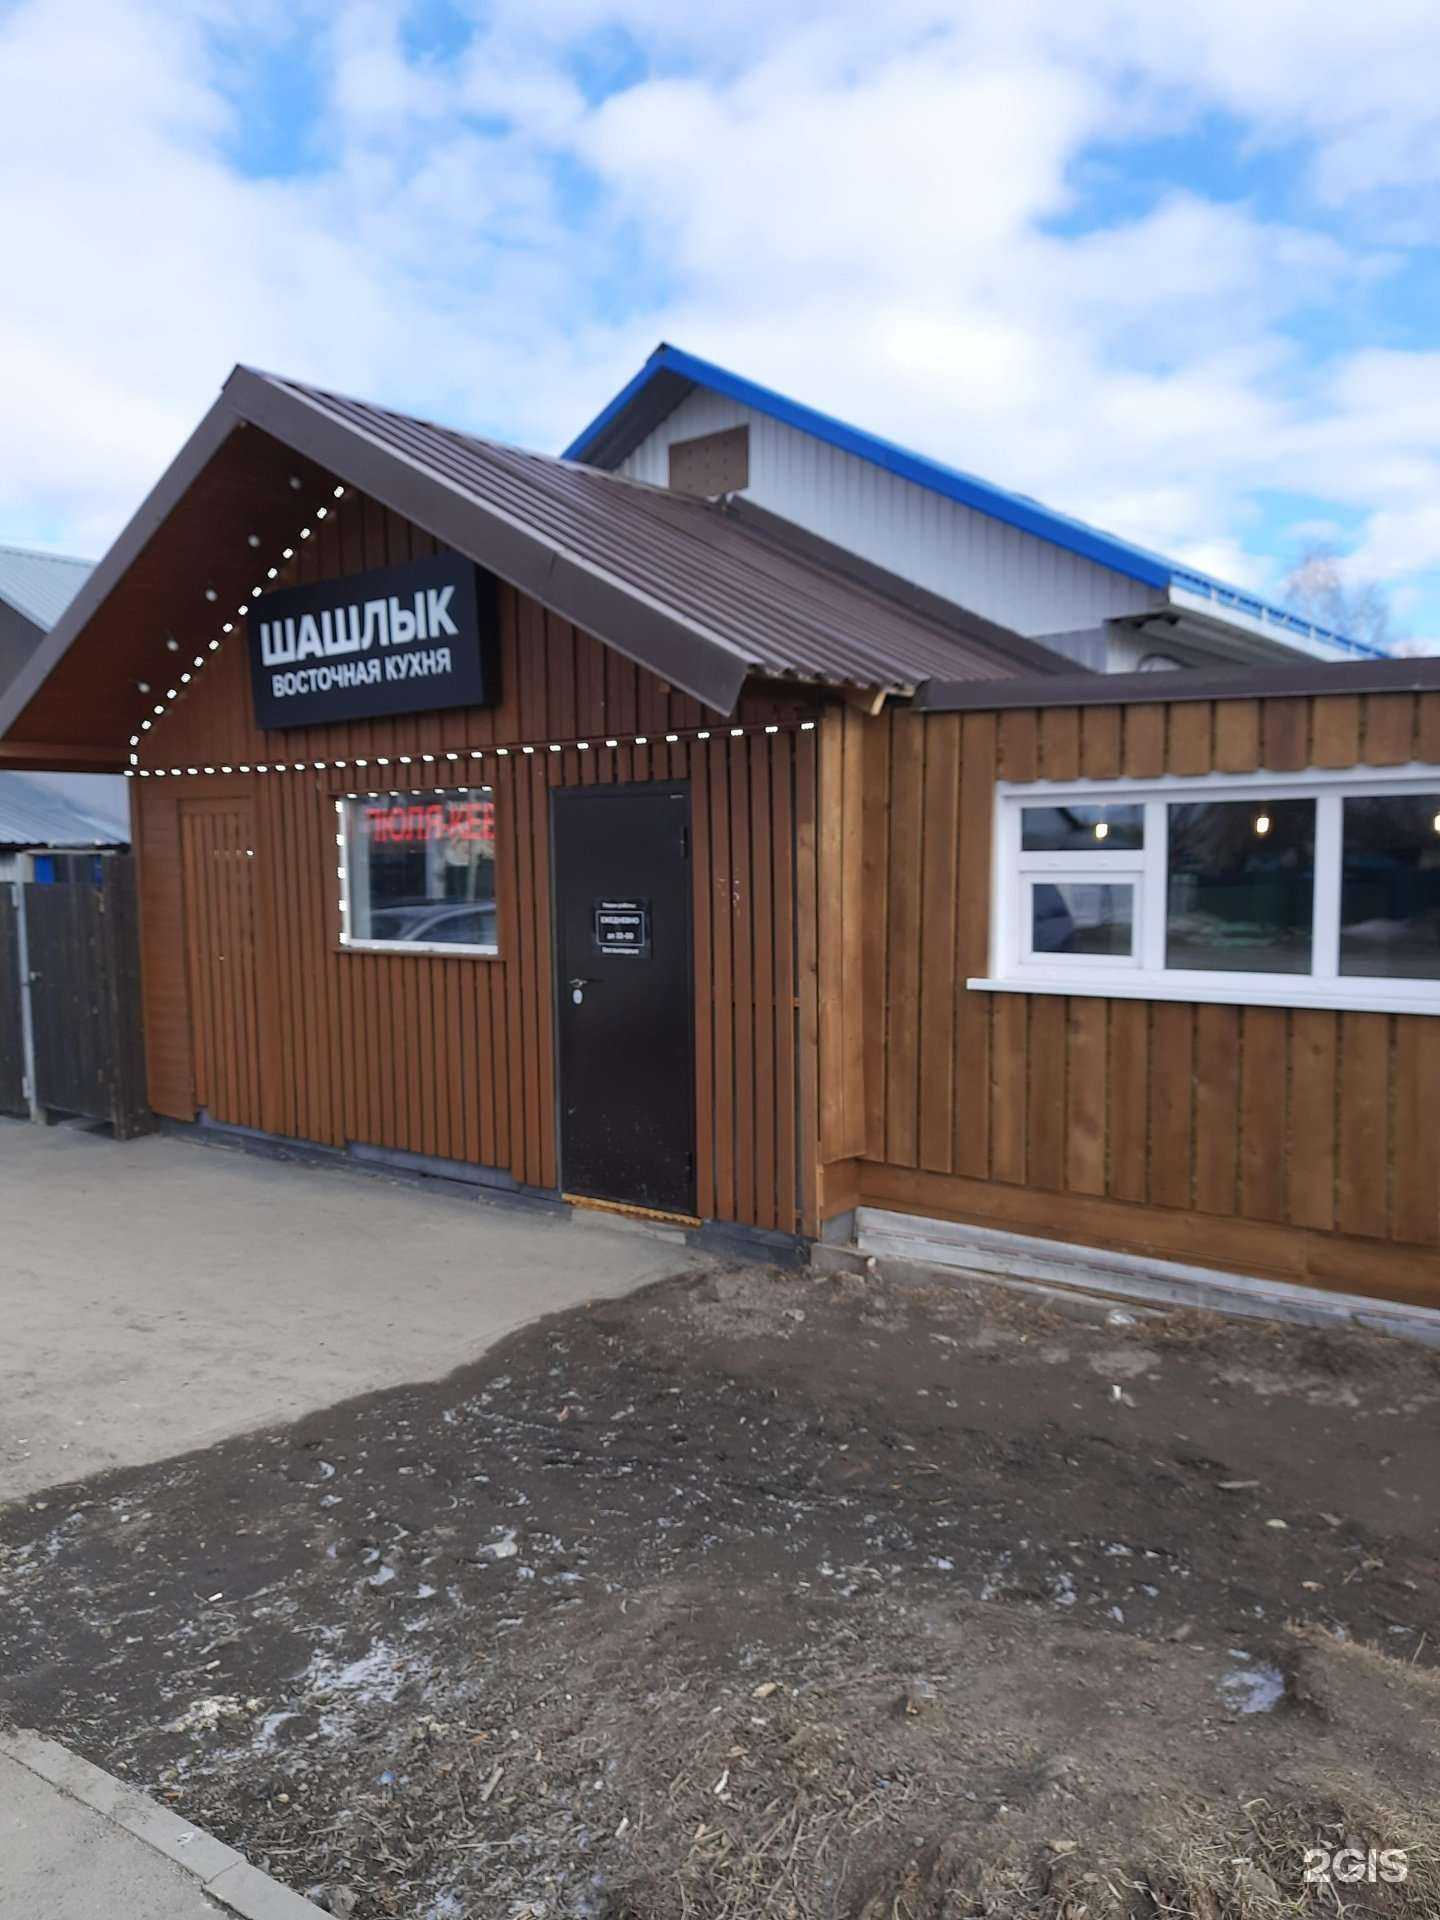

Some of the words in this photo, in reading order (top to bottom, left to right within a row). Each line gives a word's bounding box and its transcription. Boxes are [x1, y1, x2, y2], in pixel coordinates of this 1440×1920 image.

[260, 586, 459, 667] ШАШЛЫК
[272, 658, 382, 698] ВОСТОЧНАЯ
[385, 647, 452, 681] КУХНЯ
